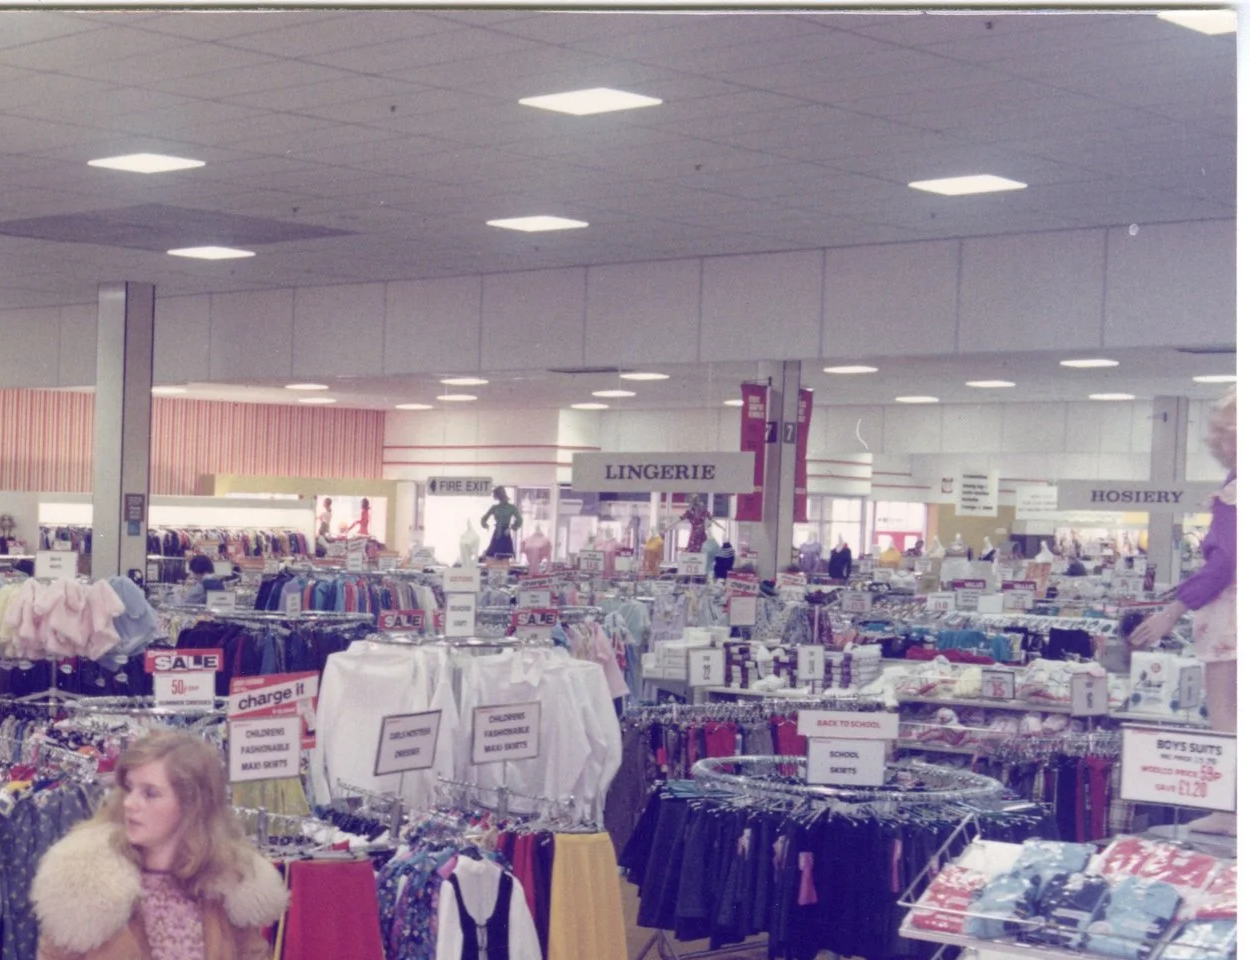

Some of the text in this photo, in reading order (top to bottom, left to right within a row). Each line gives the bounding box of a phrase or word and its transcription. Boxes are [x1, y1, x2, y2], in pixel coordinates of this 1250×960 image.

[605, 464, 715, 481] LINGERIE
[439, 480, 490, 493] FIRE EXIT
[1091, 489, 1184, 503] HOSIERY
[384, 614, 421, 628] SALE
[518, 613, 555, 625] SALE
[154, 655, 218, 671] SALE
[238, 683, 305, 710] charge it
[488, 712, 525, 723] CHILDRENS
[849, 720, 881, 728] SCHOOL
[245, 727, 285, 738] CHILDRENS
[484, 726, 530, 738] FASHIONABLE
[240, 743, 290, 754] FASHIONABLE
[484, 741, 527, 752] MAXI SKIRTS
[1157, 739, 1222, 756] BOYS SUITS
[830, 751, 859, 759] SCHOOL
[241, 759, 287, 771] MAXI SKIRTS
[830, 766, 857, 774] SKIRTS
[1155, 784, 1176, 792] SAVE
